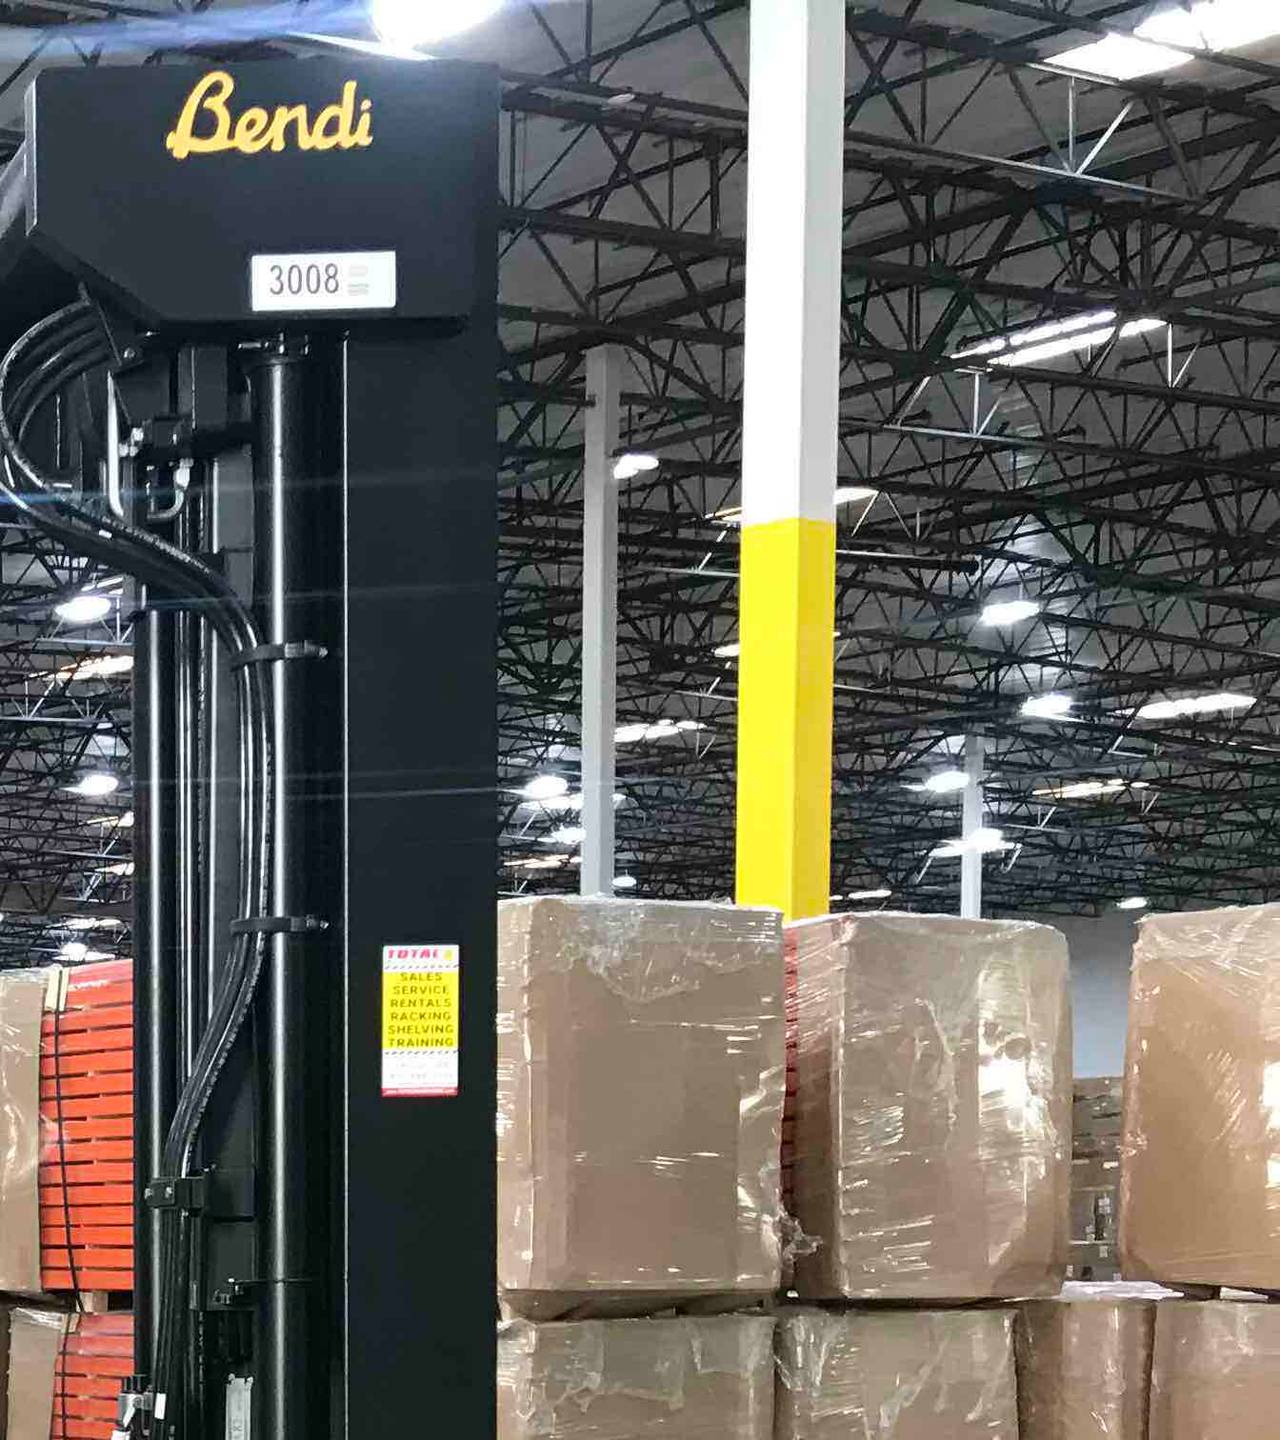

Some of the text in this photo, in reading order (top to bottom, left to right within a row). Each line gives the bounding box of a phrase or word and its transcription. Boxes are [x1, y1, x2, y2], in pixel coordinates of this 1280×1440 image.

[165, 70, 374, 160] Bendi
[268, 262, 340, 296] 3008
[399, 971, 443, 982] SALES
[392, 985, 450, 996] SERVICE
[389, 998, 453, 1009] RENTALS
[390, 1011, 453, 1022] RACKING
[387, 1023, 455, 1035] SHELVING
[388, 1036, 455, 1048] TRAINING
